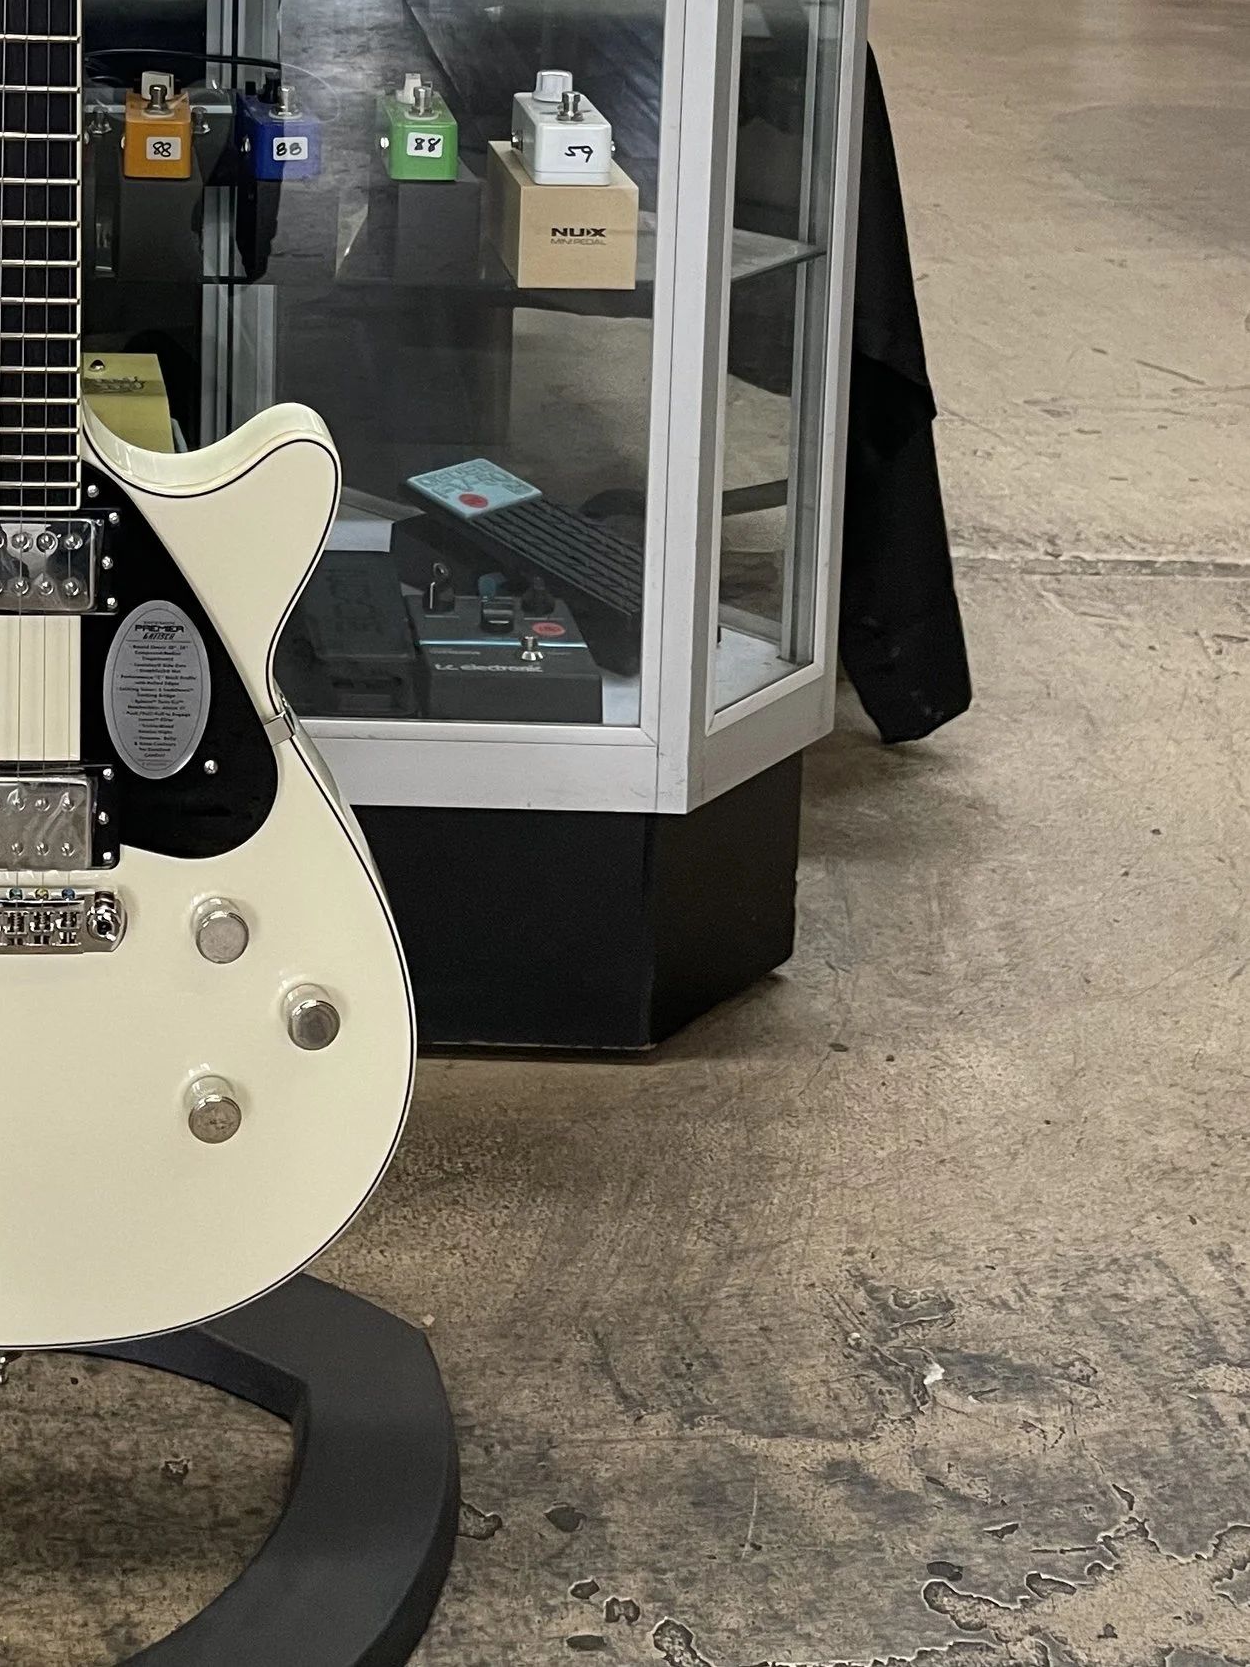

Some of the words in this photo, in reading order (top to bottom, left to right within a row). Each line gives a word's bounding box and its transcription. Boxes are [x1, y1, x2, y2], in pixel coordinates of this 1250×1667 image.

[152, 141, 172, 158] 88
[276, 142, 303, 157] 88
[414, 137, 442, 153] 88
[564, 145, 594, 163] 59
[551, 227, 607, 238] NUX
[573, 238, 608, 246] PEDAL
[135, 624, 185, 633] PREMIER
[460, 663, 545, 673] electronic
